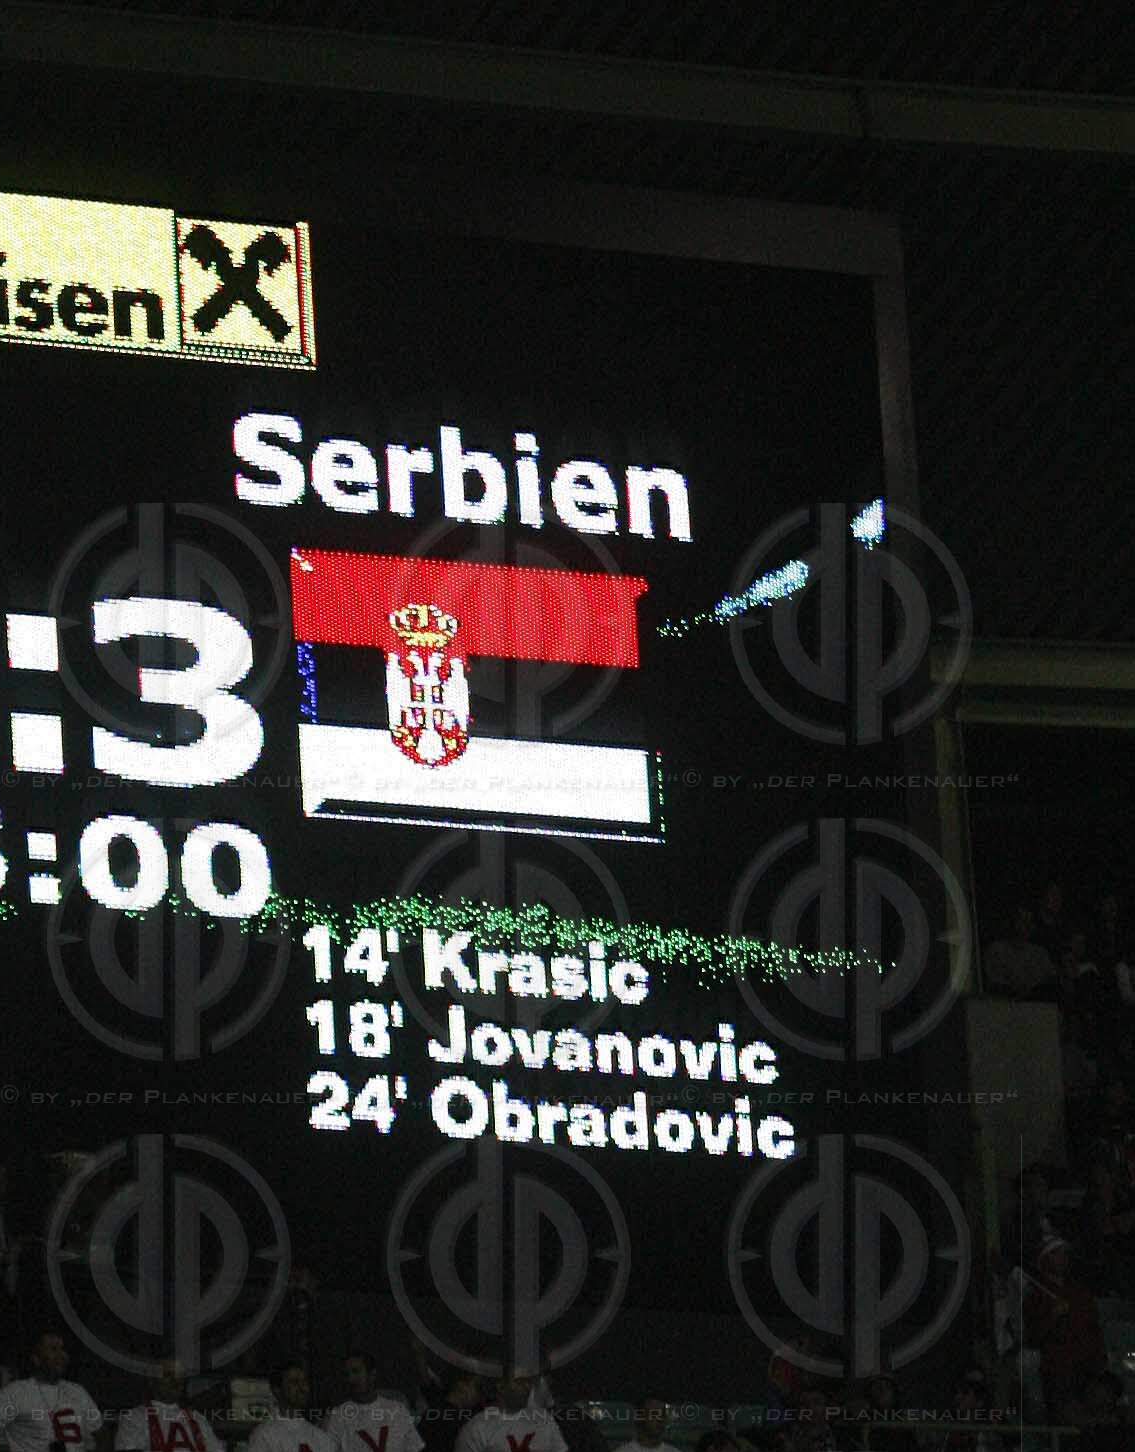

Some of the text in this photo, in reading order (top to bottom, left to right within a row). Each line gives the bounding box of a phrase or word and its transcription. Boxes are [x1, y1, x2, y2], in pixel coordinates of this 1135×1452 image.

[233, 409, 693, 543] Serbien
[421, 926, 651, 1005] Krasic
[428, 1003, 780, 1085] Jovanovic
[429, 1074, 796, 1160] Obradovic
